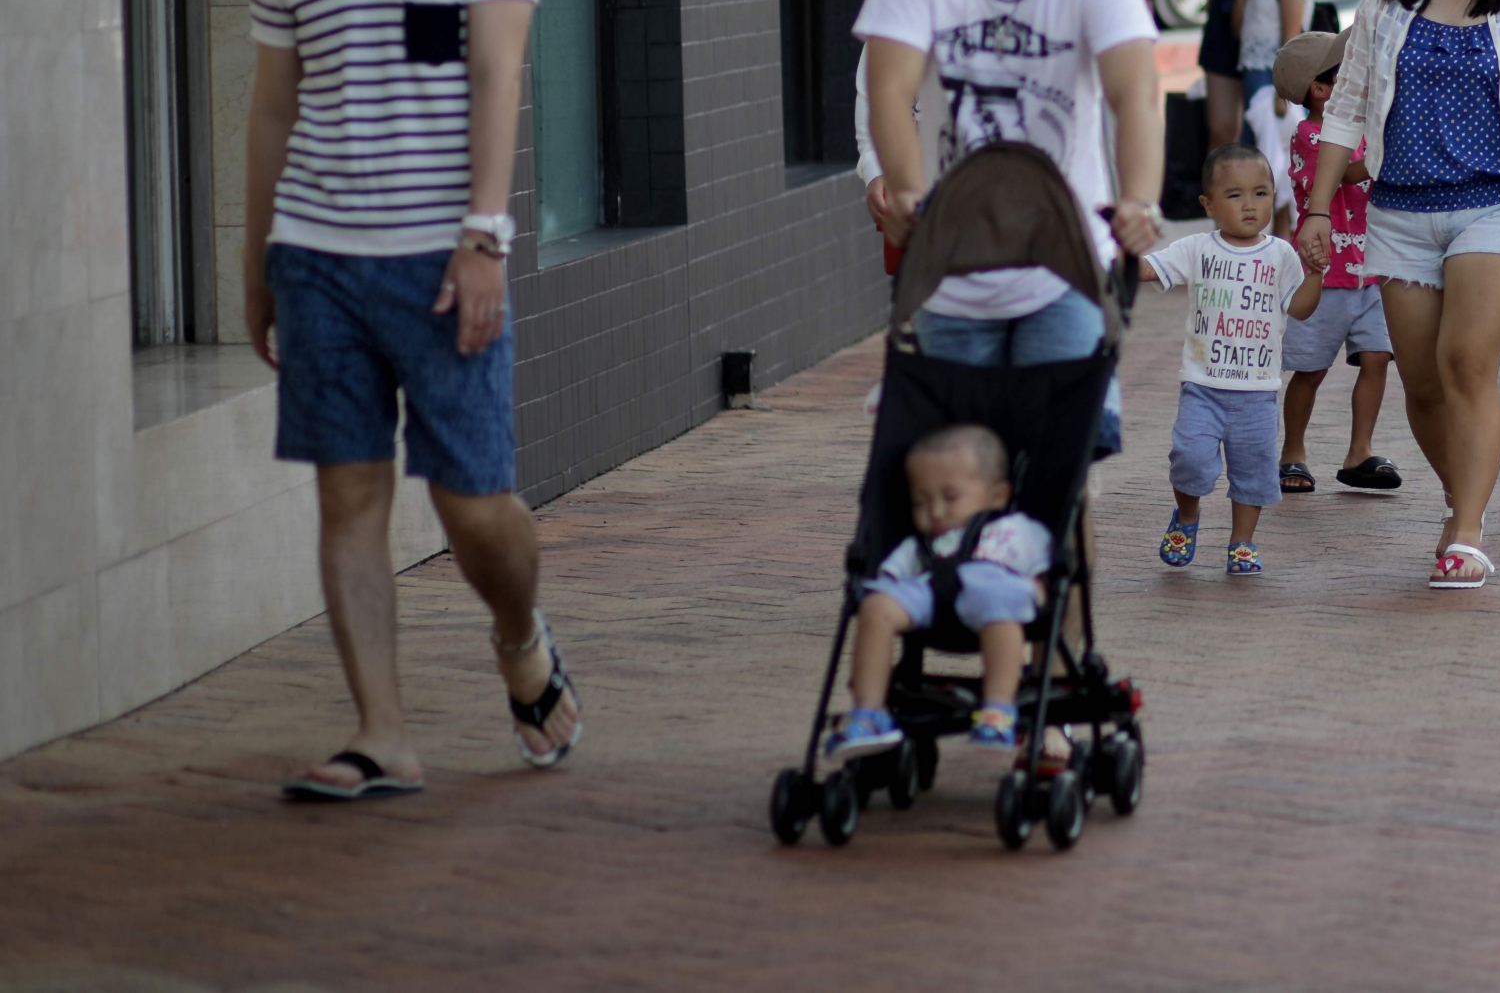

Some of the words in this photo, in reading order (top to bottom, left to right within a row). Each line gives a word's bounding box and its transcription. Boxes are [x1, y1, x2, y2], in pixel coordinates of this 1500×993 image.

[1201, 254, 1246, 282] WHILE
[1252, 259, 1276, 286] THE
[1194, 283, 1233, 309] TRAIN
[1194, 310, 1209, 335] ON
[1214, 311, 1271, 340] ACROSS
[1210, 339, 1255, 367] STATE
